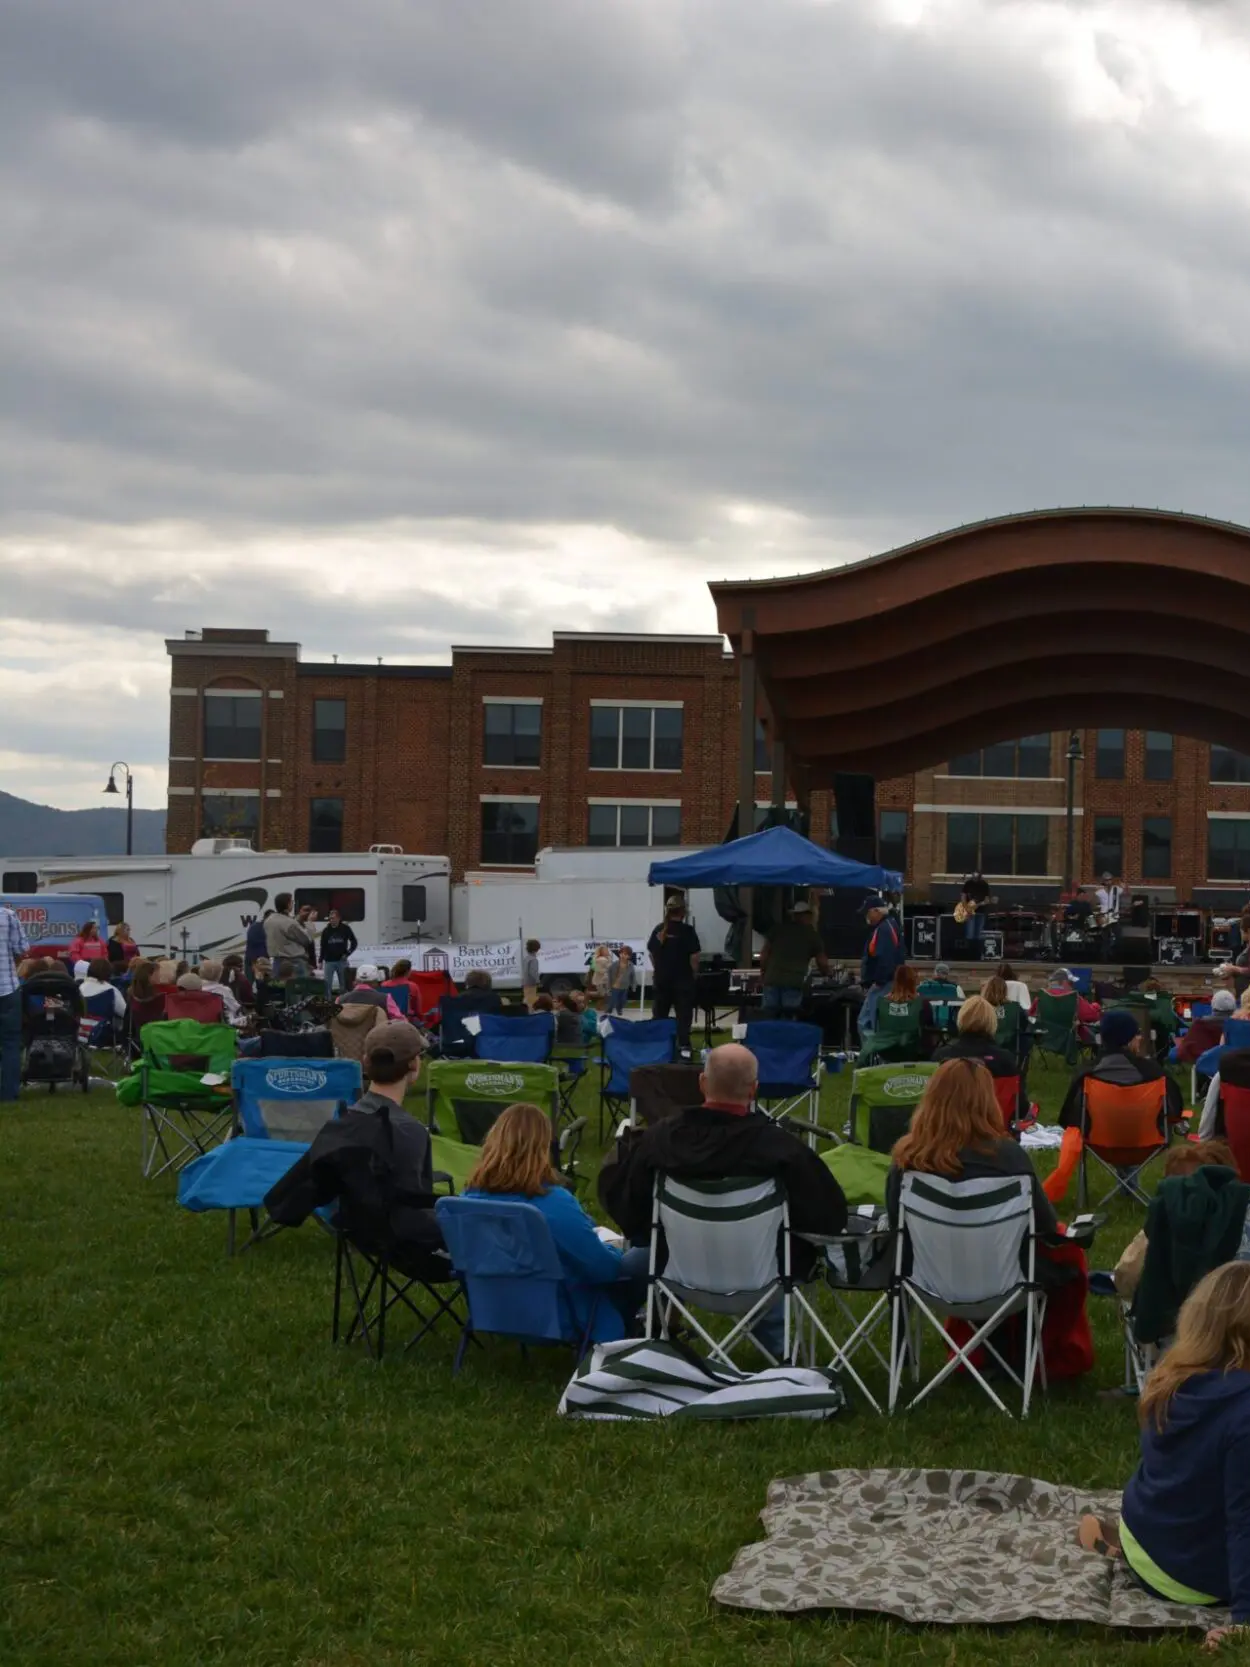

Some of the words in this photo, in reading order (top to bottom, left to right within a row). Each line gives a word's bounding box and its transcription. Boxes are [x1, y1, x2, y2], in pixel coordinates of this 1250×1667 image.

[459, 945, 493, 957] Bank
[497, 946, 512, 955] of
[453, 956, 516, 968] Botetourt
